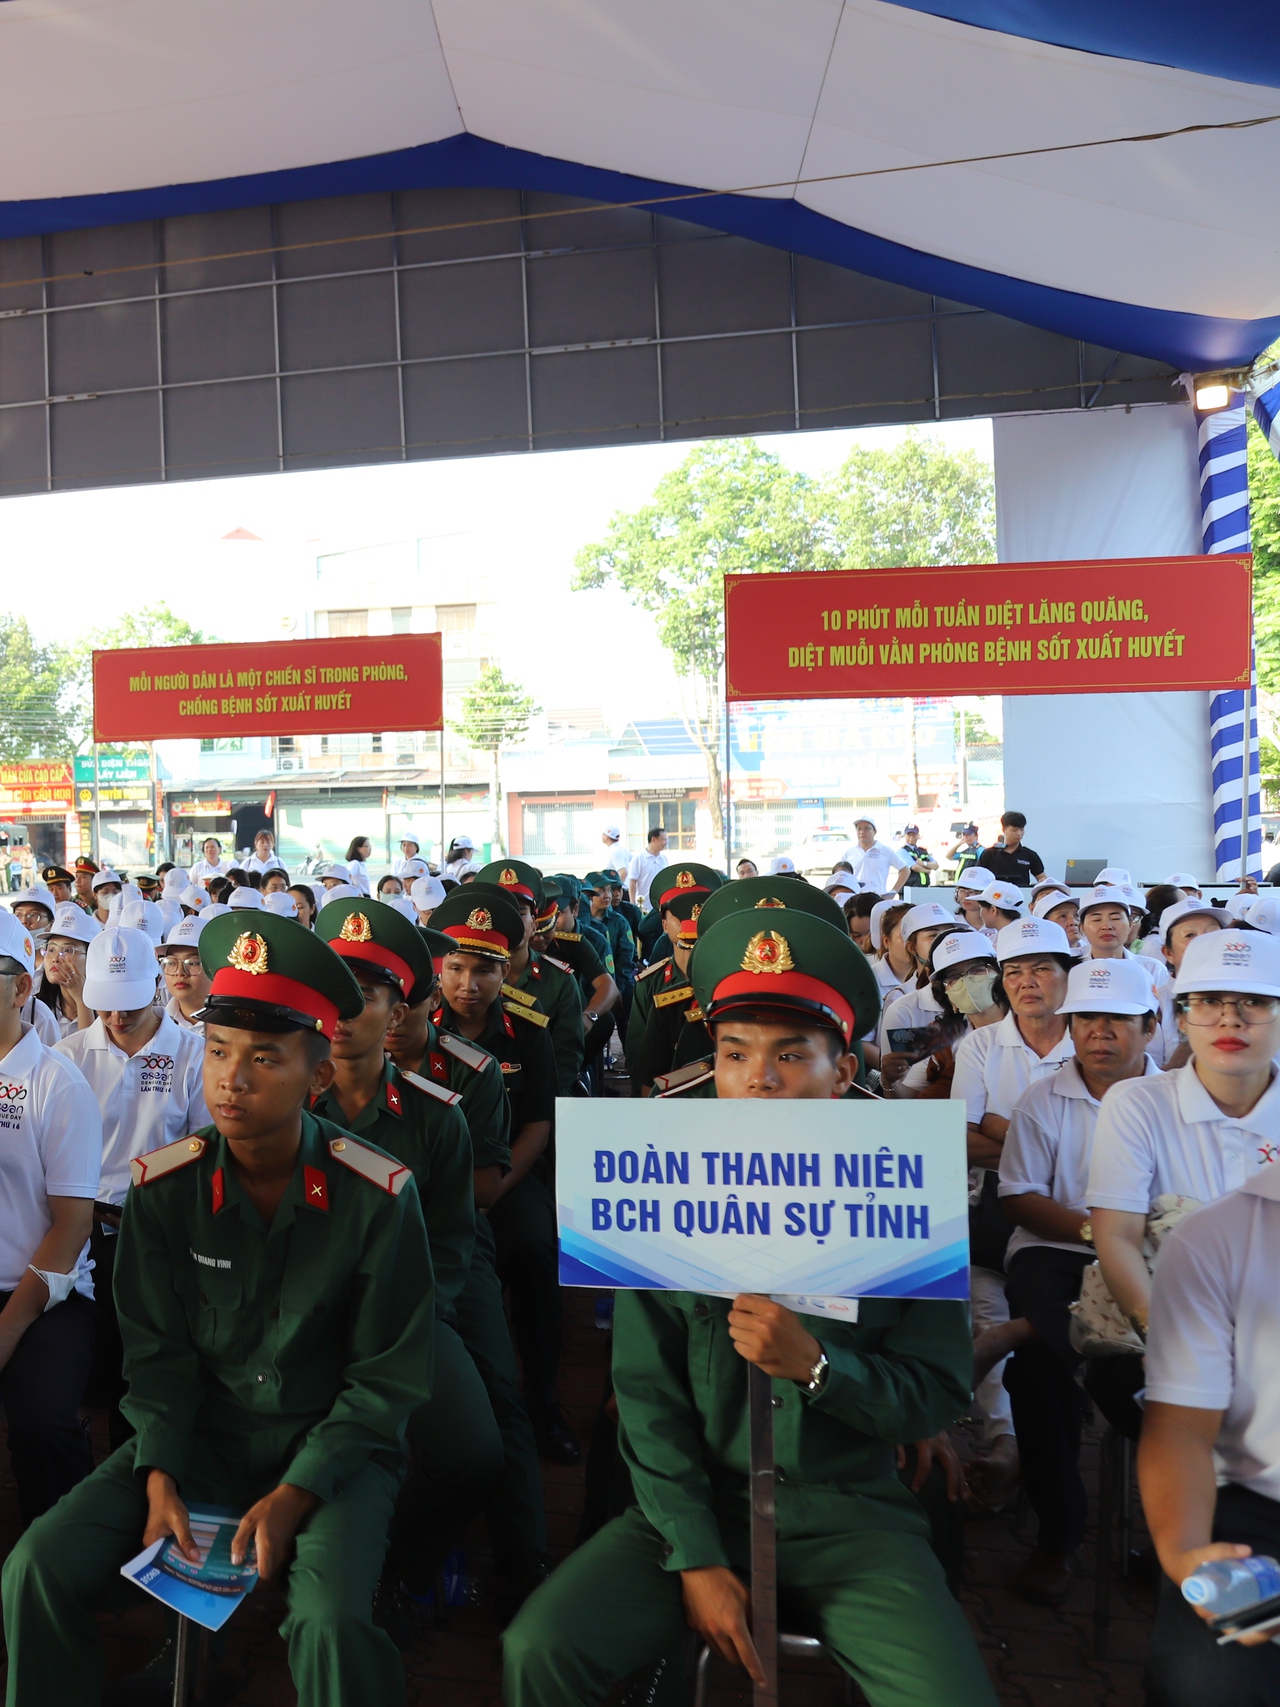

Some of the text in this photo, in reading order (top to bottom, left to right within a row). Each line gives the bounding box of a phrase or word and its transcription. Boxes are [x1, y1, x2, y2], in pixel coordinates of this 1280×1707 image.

[821, 596, 1149, 631] 10 PHÚT MỖI TUẦN DIỆT LĂNG QUĂNG,
[788, 628, 1185, 671] DIỆT MUỖI VẰN PHÒNG BỆNH SỐT XUẤT HUYẾT
[130, 664, 408, 692] MỖI NGƯỜI DÂN LÀ MỘT CHIẾN SĨ TRONG PHÒNG,
[179, 689, 352, 717] CHỐNG BỆNH SỐT XUẤT HUYẾT
[593, 1143, 923, 1189] ĐOÀN THANH NIÊN
[591, 1192, 930, 1245] BCH QUÂN SỰ TỈNH
[198, 1255, 216, 1267] QUANG
[217, 1259, 232, 1269] VINH
